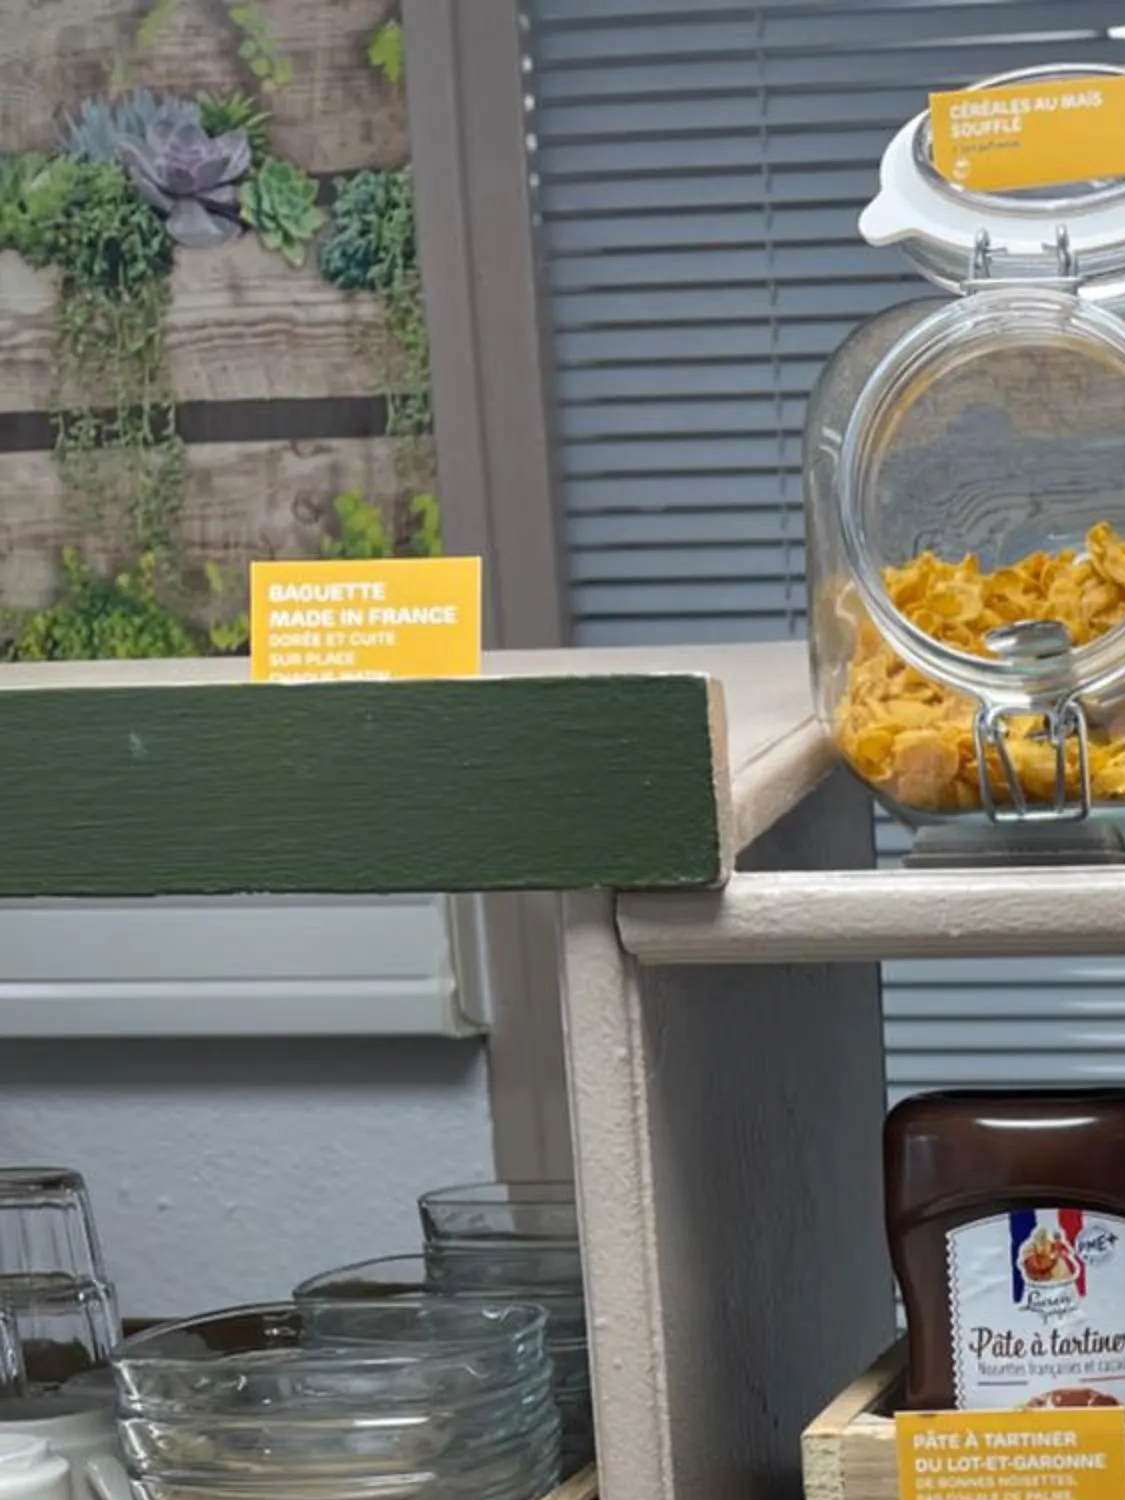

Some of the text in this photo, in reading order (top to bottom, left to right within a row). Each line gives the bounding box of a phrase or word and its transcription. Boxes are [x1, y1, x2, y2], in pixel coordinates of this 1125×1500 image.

[949, 97, 1032, 119] CÉRÉALES
[1034, 95, 1057, 112] AU
[951, 116, 1022, 138] SOUFFLÉ
[268, 582, 386, 602] BAGUETTE
[269, 605, 457, 628] MADE IN FRANCE
[269, 631, 396, 648] DORÉE ET CUITE
[269, 651, 355, 667] SUR PLACE
[969, 1326, 1026, 1359] Pâte
[1031, 1326, 1048, 1357] à
[1084, 1359, 1095, 1373] et
[913, 1428, 1078, 1450] PÂTE À TARTINER
[915, 1453, 1107, 1473] DU LOT-ET-GARONNE
[938, 1476, 995, 1489] BONNES
